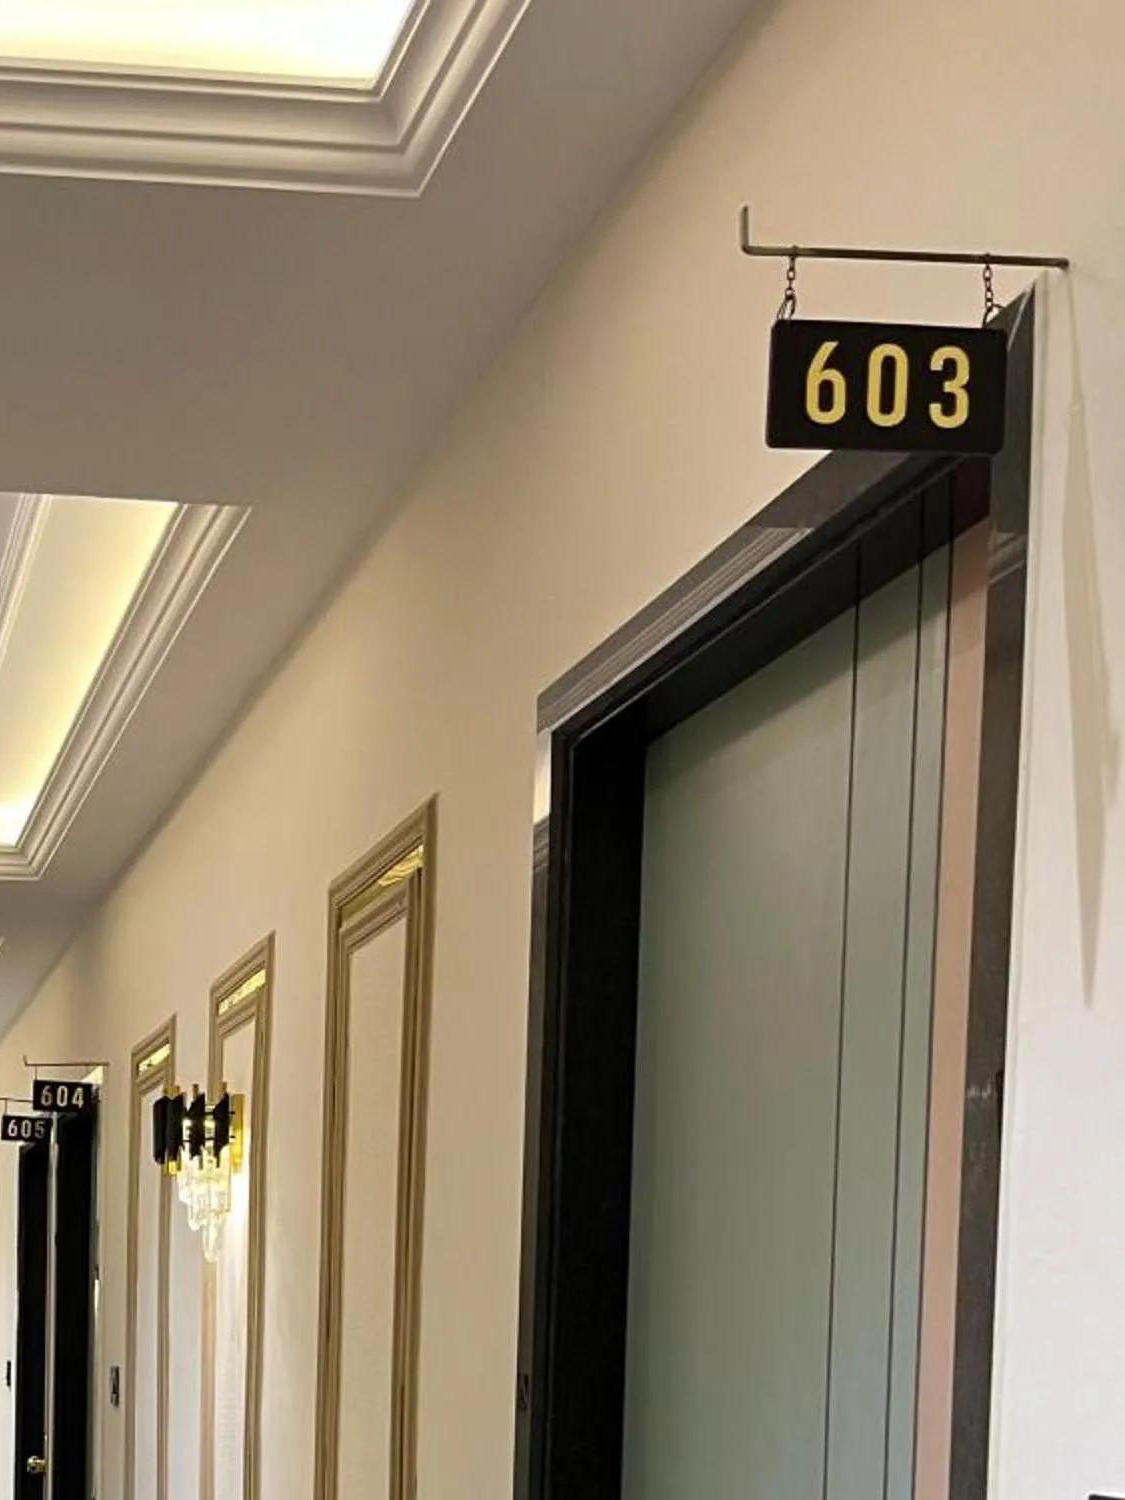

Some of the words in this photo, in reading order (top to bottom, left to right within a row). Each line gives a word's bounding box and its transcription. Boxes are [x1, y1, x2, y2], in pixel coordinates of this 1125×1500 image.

[806, 341, 971, 429] 603
[41, 1085, 84, 1108] 604
[8, 1119, 45, 1138] 605
